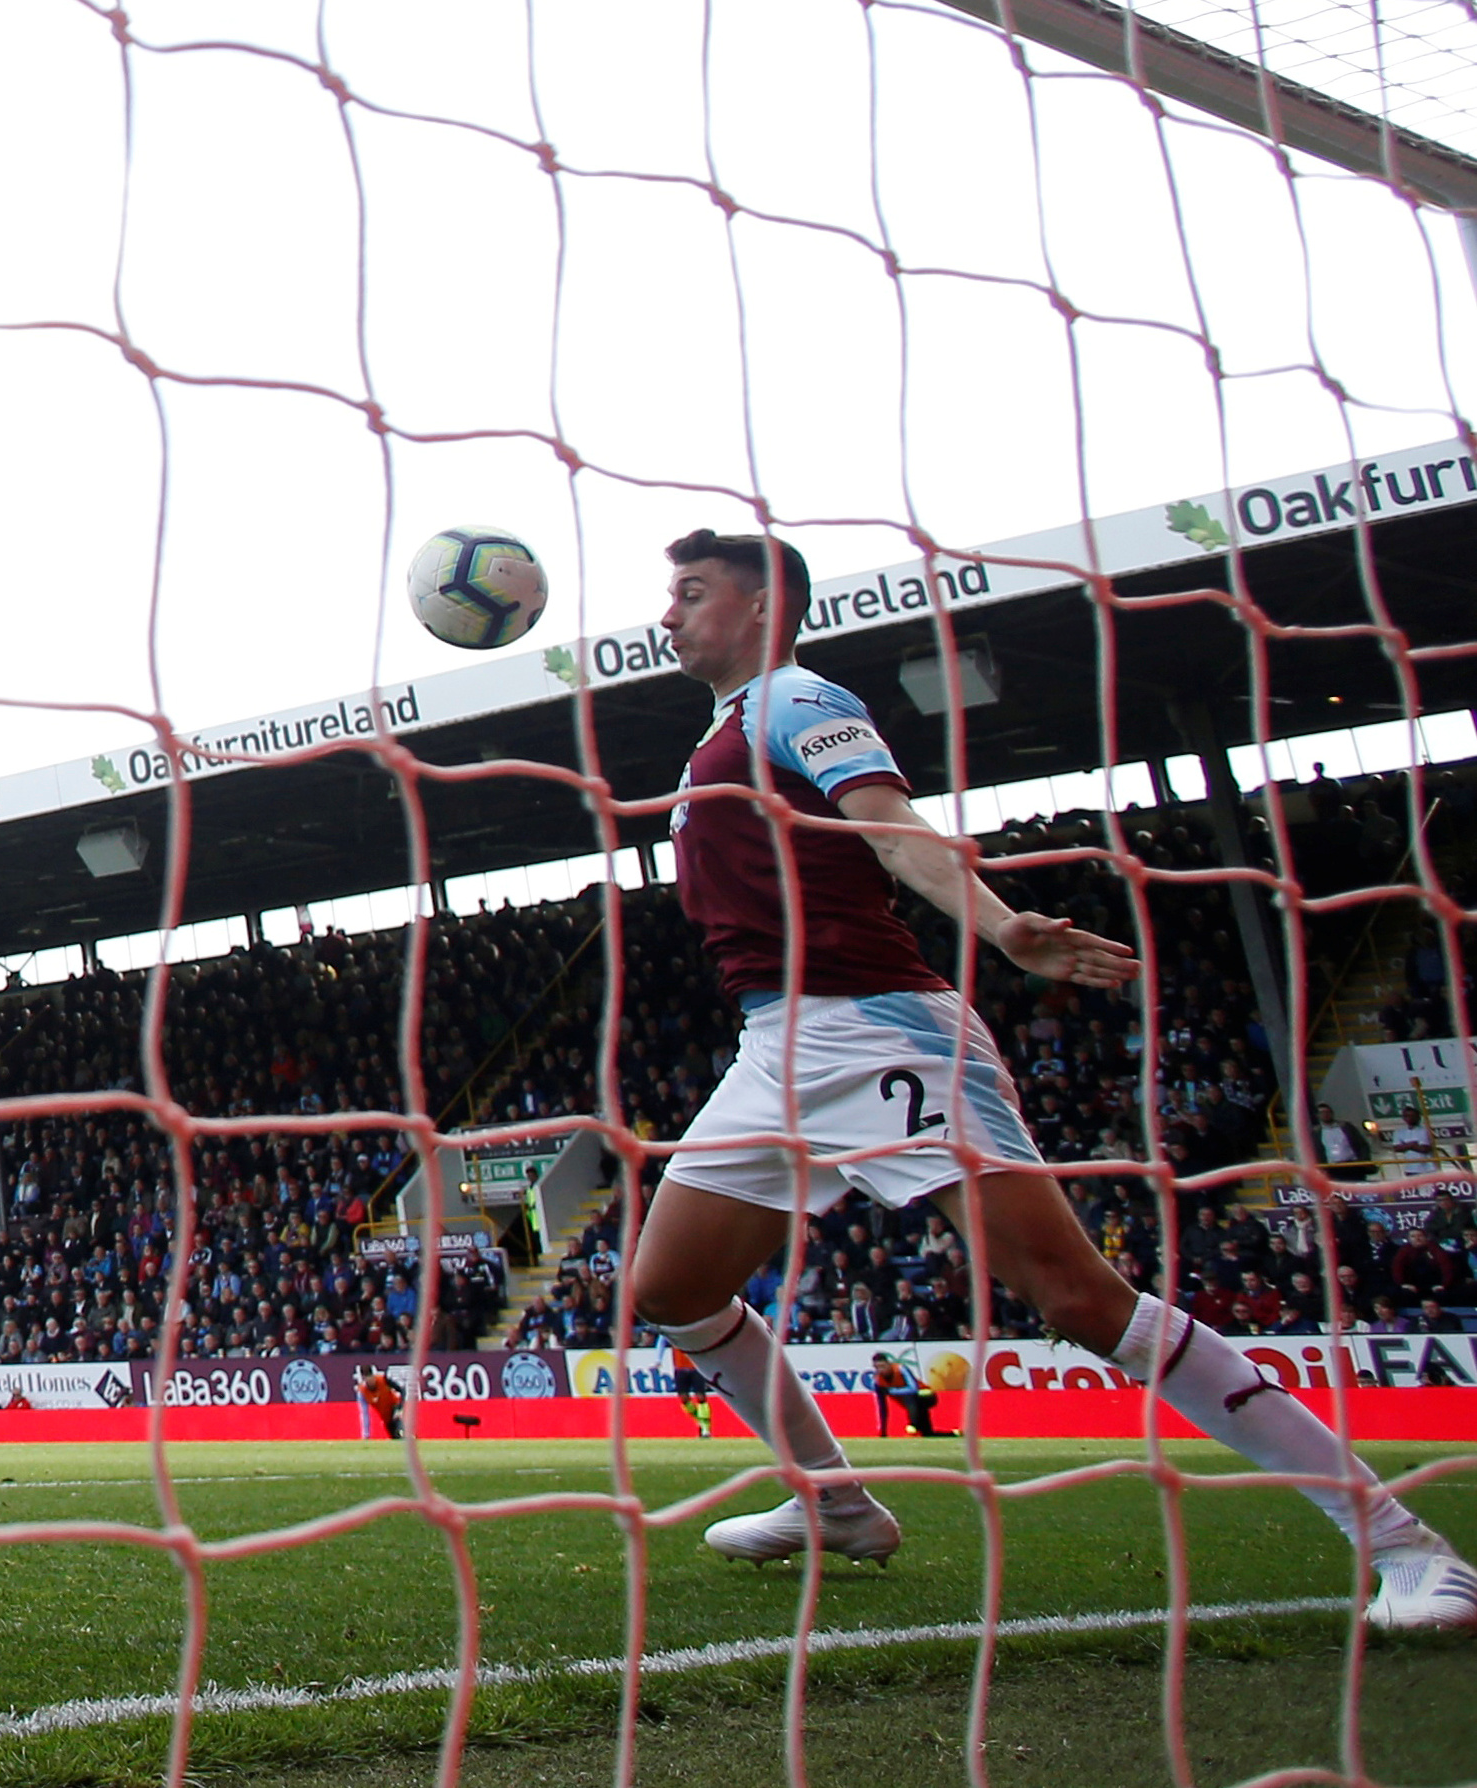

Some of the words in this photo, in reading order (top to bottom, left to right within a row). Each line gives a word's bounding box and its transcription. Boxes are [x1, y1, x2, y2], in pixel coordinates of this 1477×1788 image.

[880, 1068, 945, 1137] 2
[28, 1371, 92, 1393] Homes
[1367, 1336, 1477, 1388] FA
[143, 1368, 271, 1406] LaBa360
